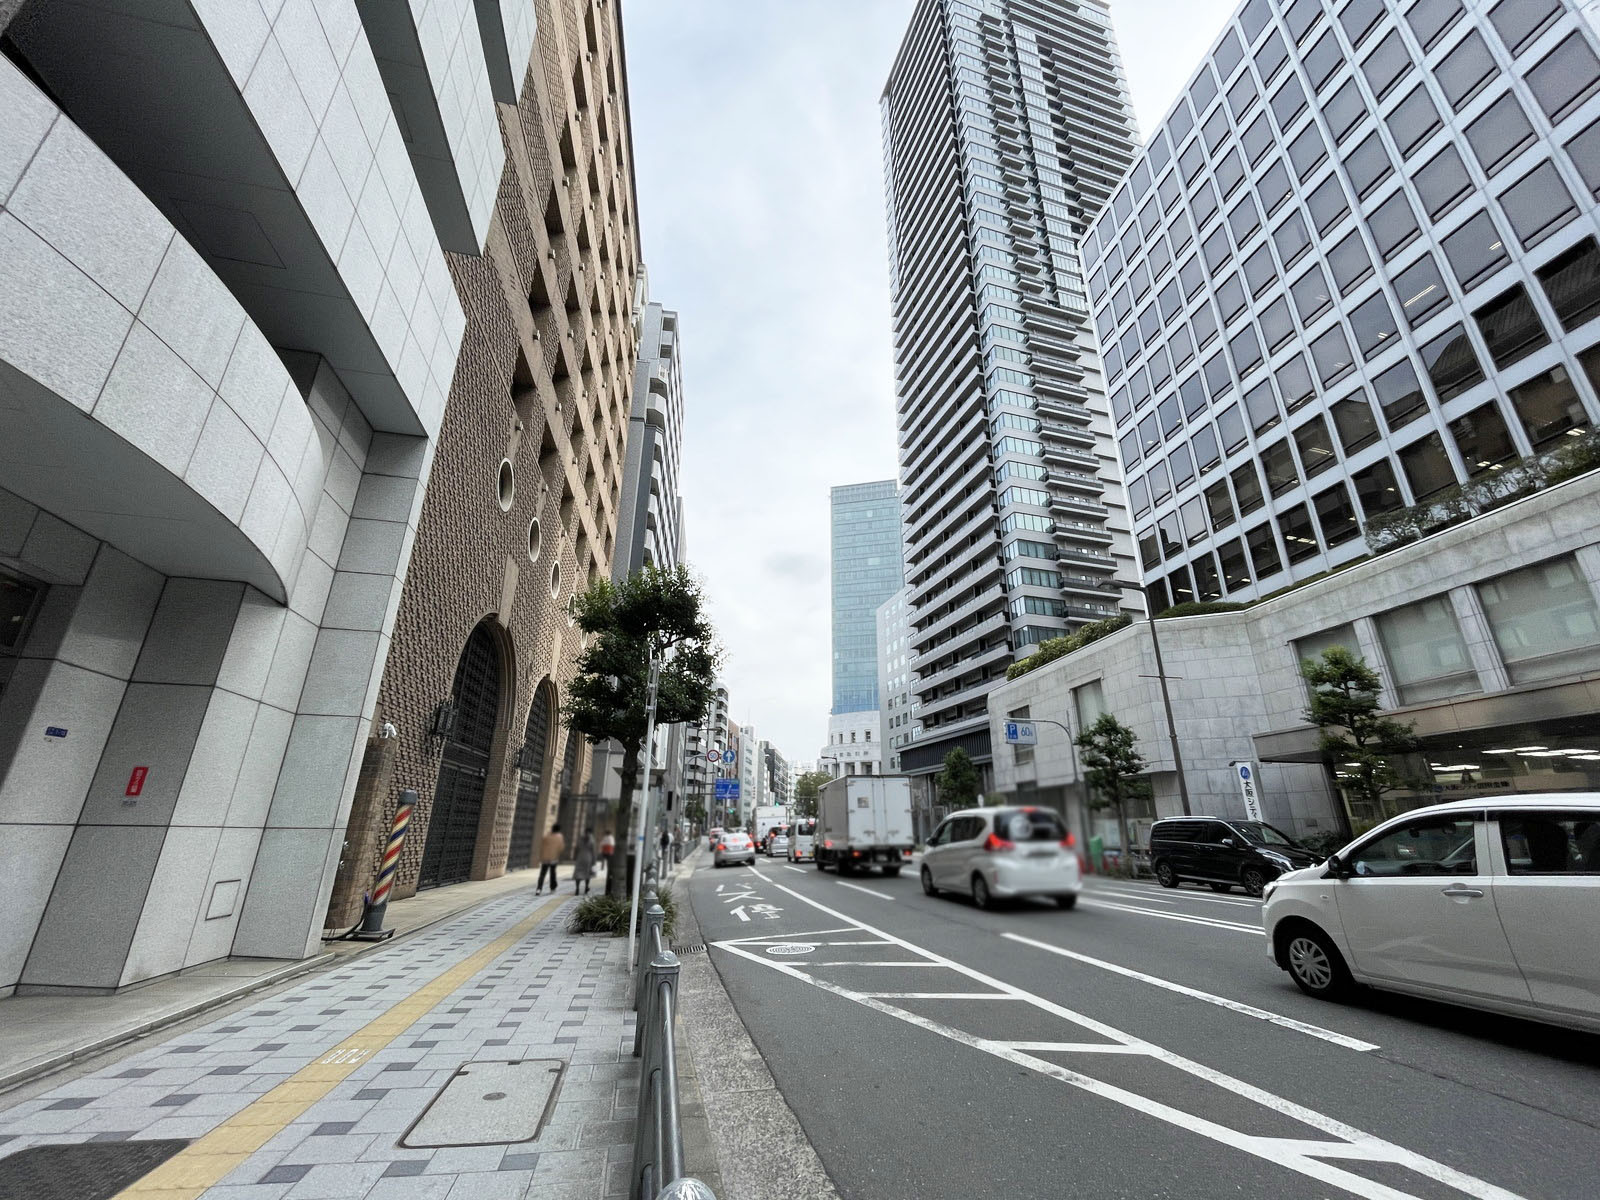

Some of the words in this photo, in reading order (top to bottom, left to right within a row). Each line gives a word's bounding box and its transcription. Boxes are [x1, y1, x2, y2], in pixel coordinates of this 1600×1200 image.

[1010, 725, 1016, 734] P
[1244, 780, 1258, 818] 大阪シティ
